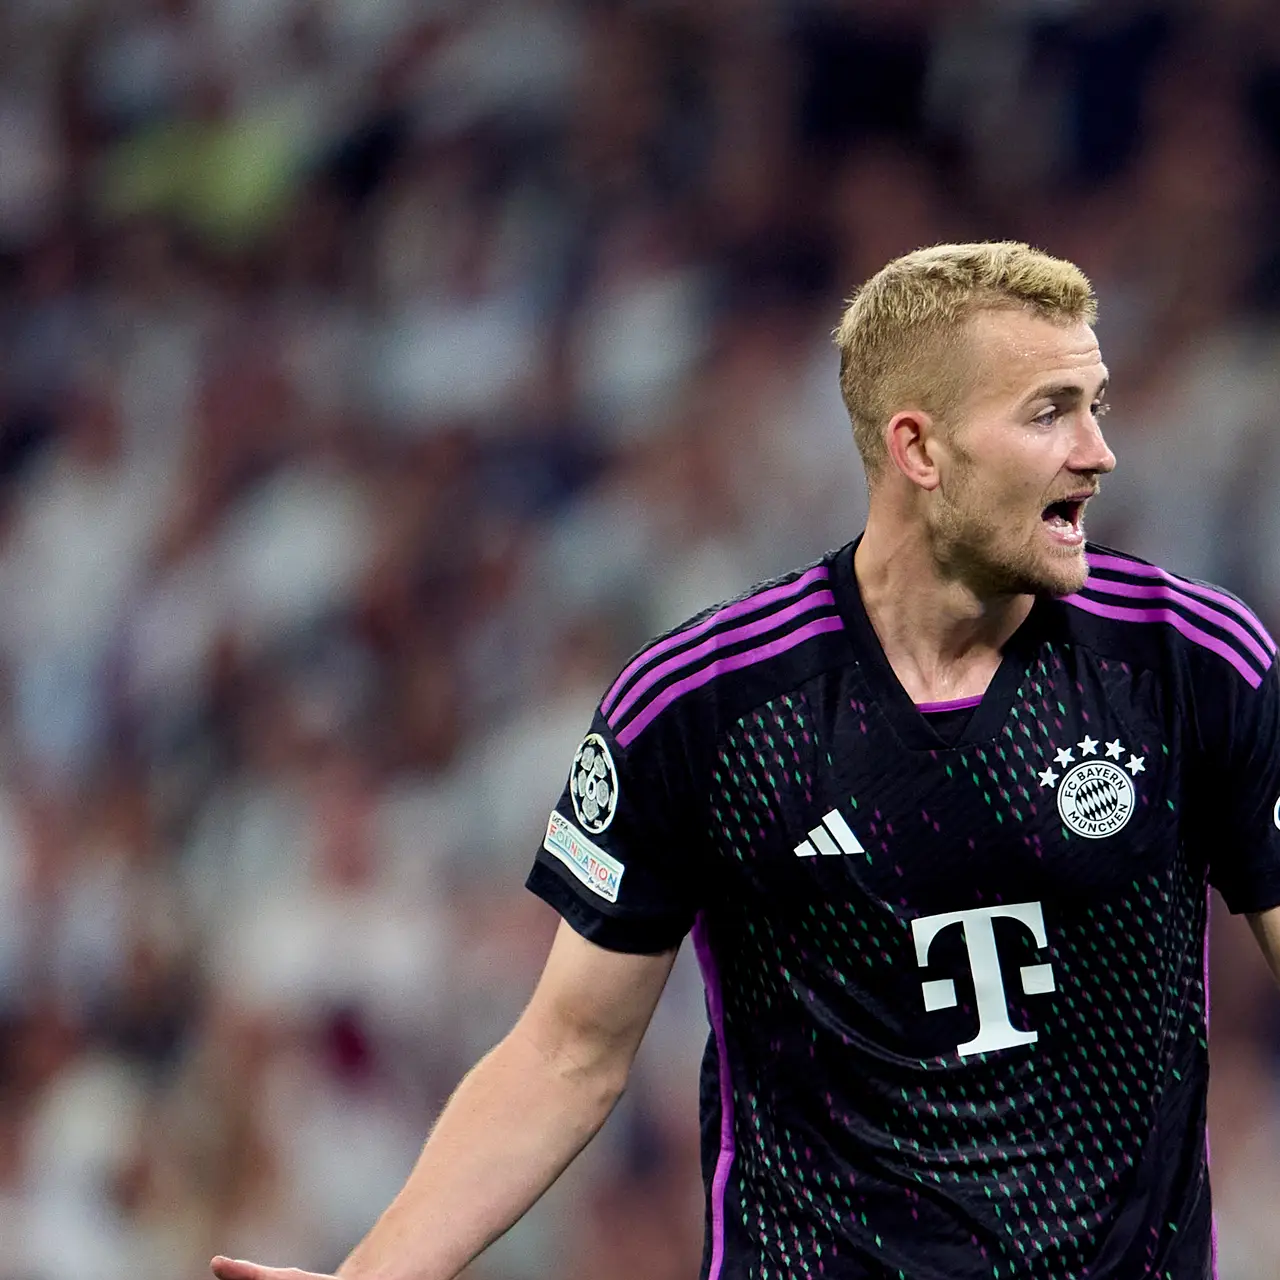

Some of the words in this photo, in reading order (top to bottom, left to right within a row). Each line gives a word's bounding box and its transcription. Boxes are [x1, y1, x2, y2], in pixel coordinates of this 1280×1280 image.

[1065, 781, 1077, 798] FC
[1077, 767, 1126, 791] BAYERN
[1068, 803, 1128, 833] MÜNCHEN
[548, 824, 618, 889] FOUNDATION
[911, 901, 1056, 1057] T
